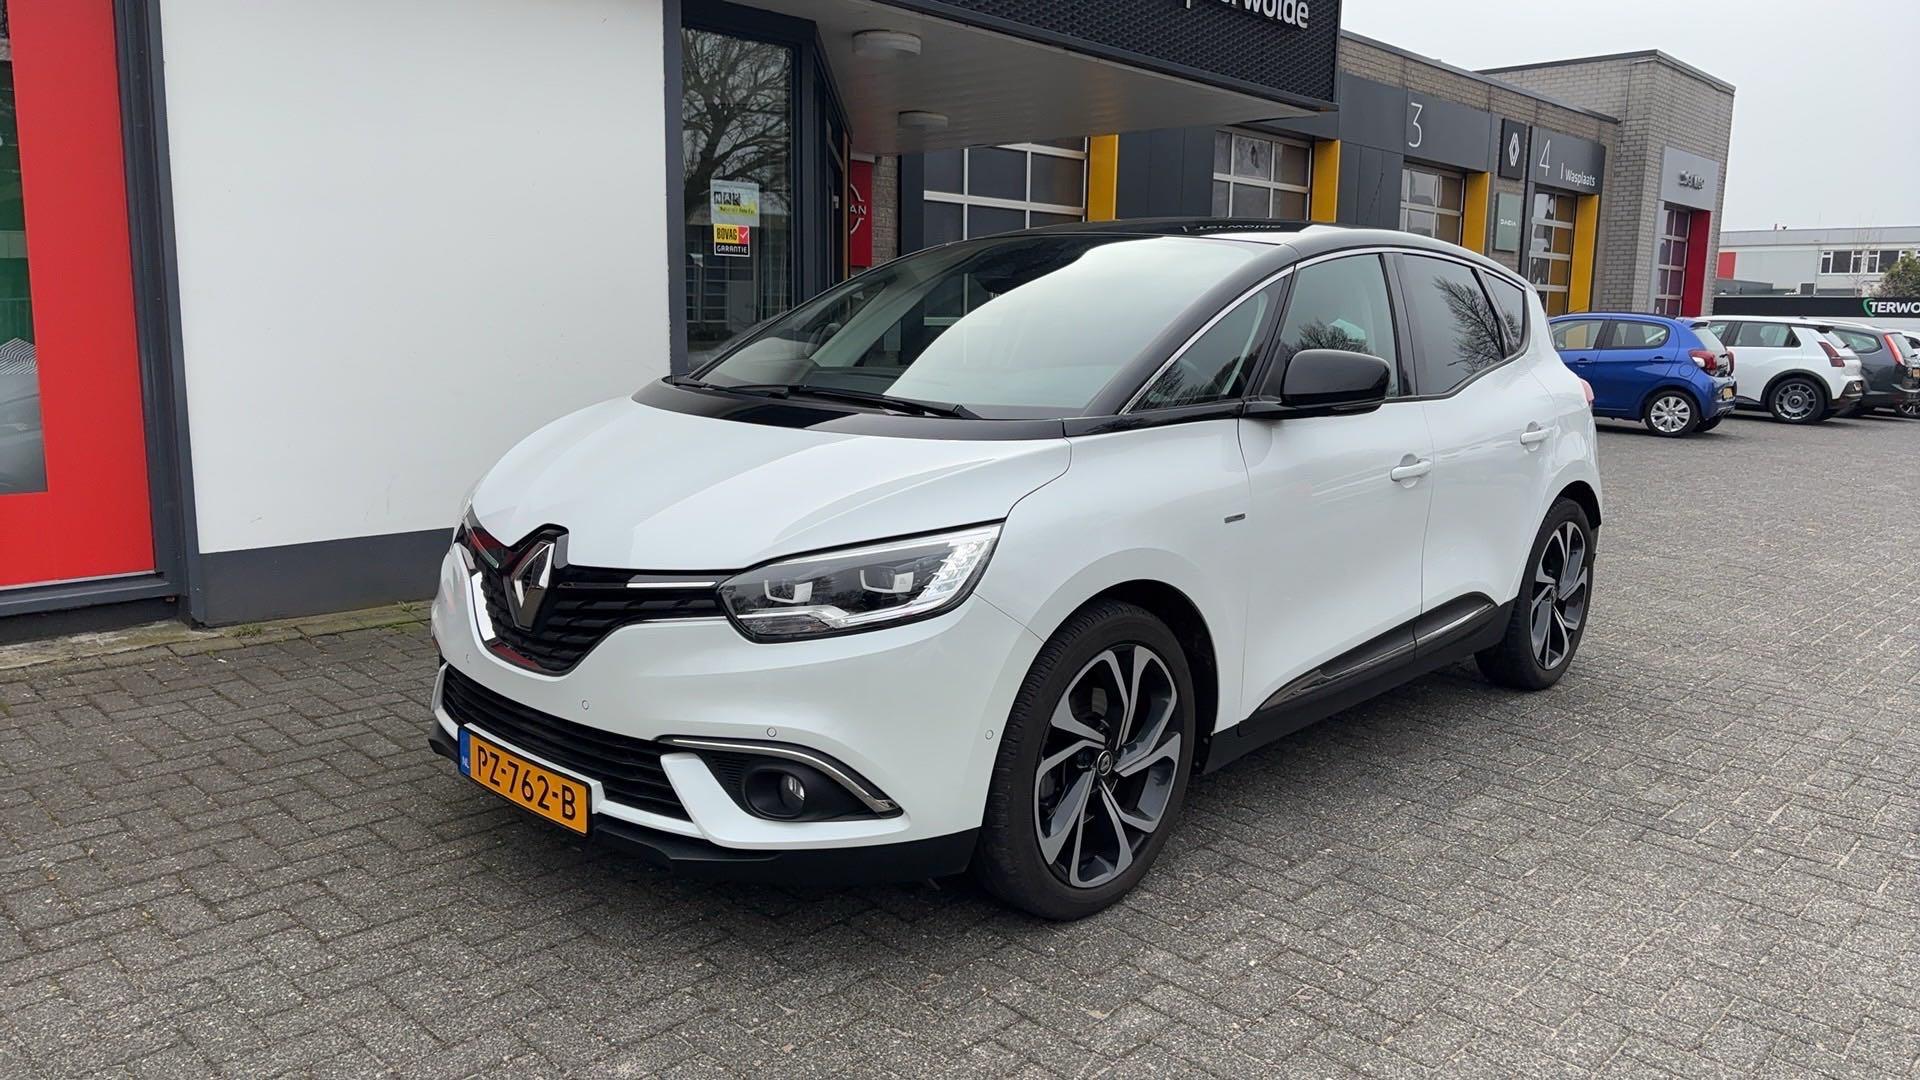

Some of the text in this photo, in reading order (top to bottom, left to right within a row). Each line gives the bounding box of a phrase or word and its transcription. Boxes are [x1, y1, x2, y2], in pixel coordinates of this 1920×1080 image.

[1408, 102, 1423, 148] 3
[1539, 139, 1551, 176] 4
[716, 227, 738, 241] BOVAG
[716, 245, 747, 254] GARANTIE
[477, 744, 576, 821] PZ-762-B
